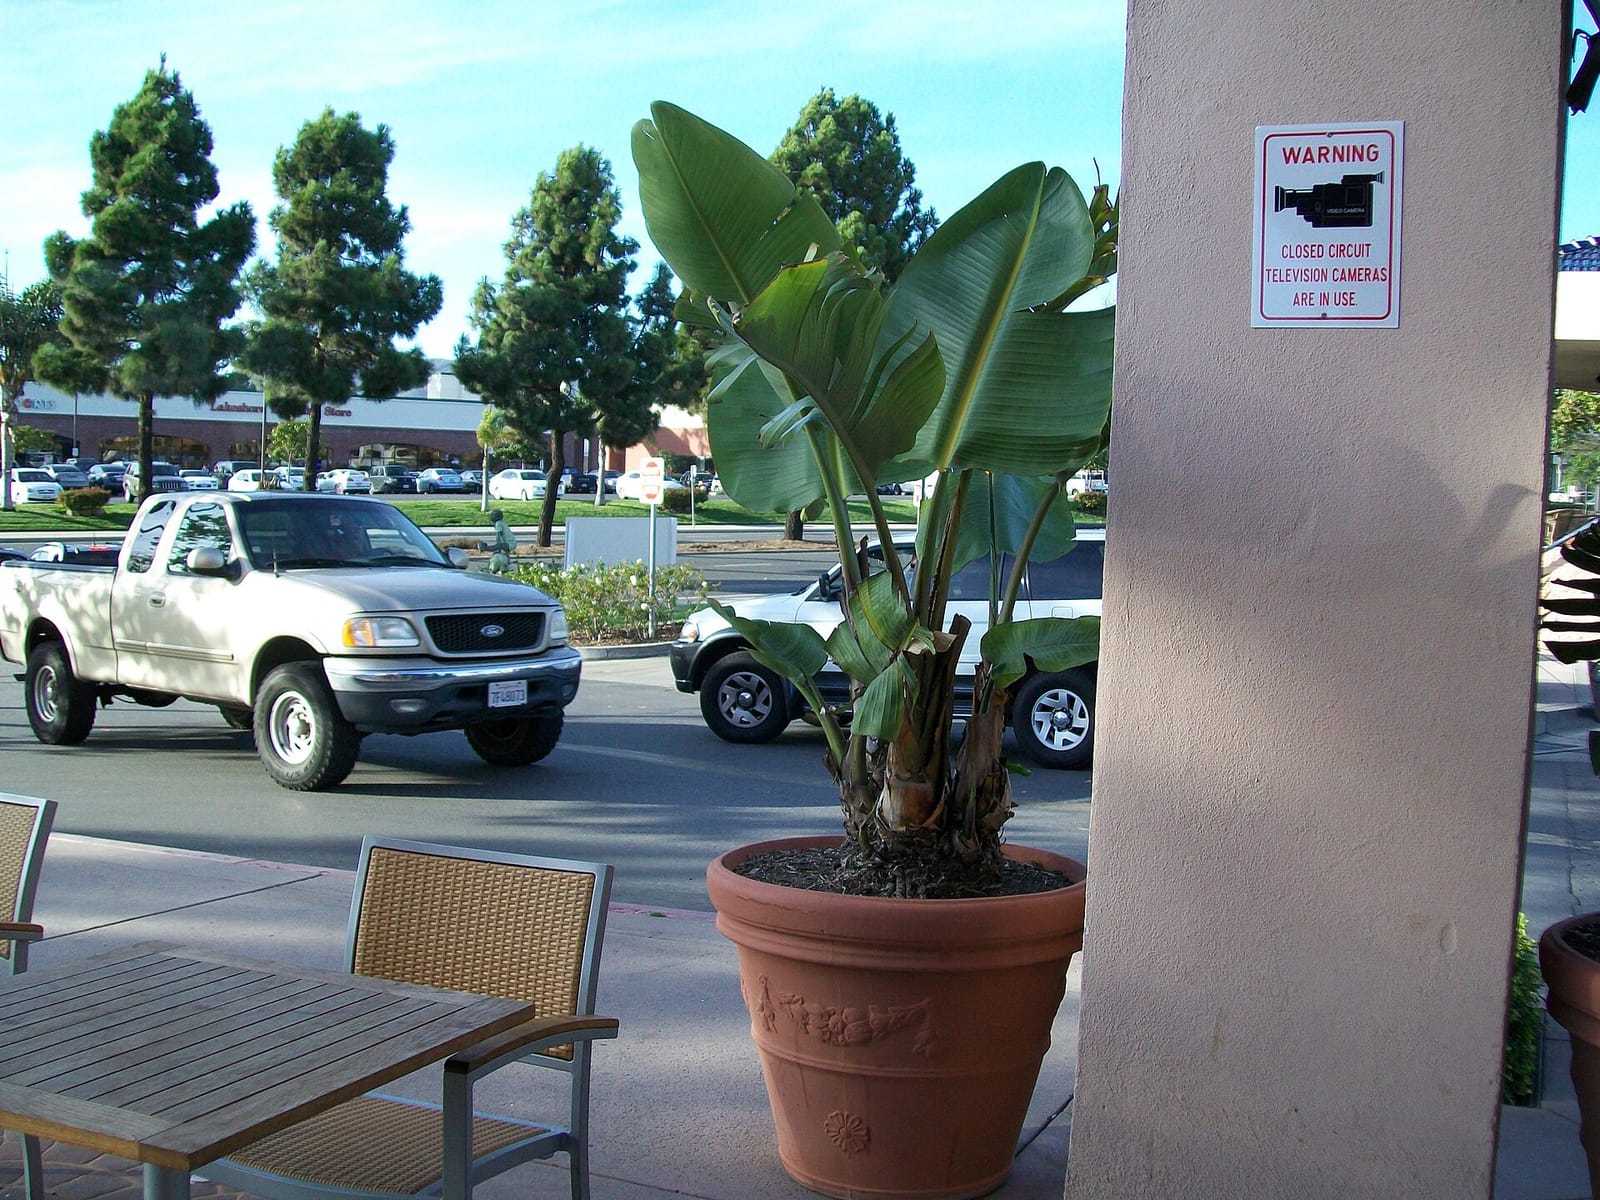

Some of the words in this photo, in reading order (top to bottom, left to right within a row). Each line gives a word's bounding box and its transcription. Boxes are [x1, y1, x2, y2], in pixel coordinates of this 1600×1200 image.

[1282, 144, 1380, 165] WARNING
[1281, 244, 1325, 259] CLOSED
[1328, 243, 1372, 258] CIRCUIT
[1265, 268, 1328, 283] TELEVISION
[1332, 267, 1388, 282] CAMERAS
[1293, 292, 1315, 307] ARE
[1319, 292, 1330, 306] IN
[1334, 292, 1358, 306] USE.
[324, 406, 352, 417] Store
